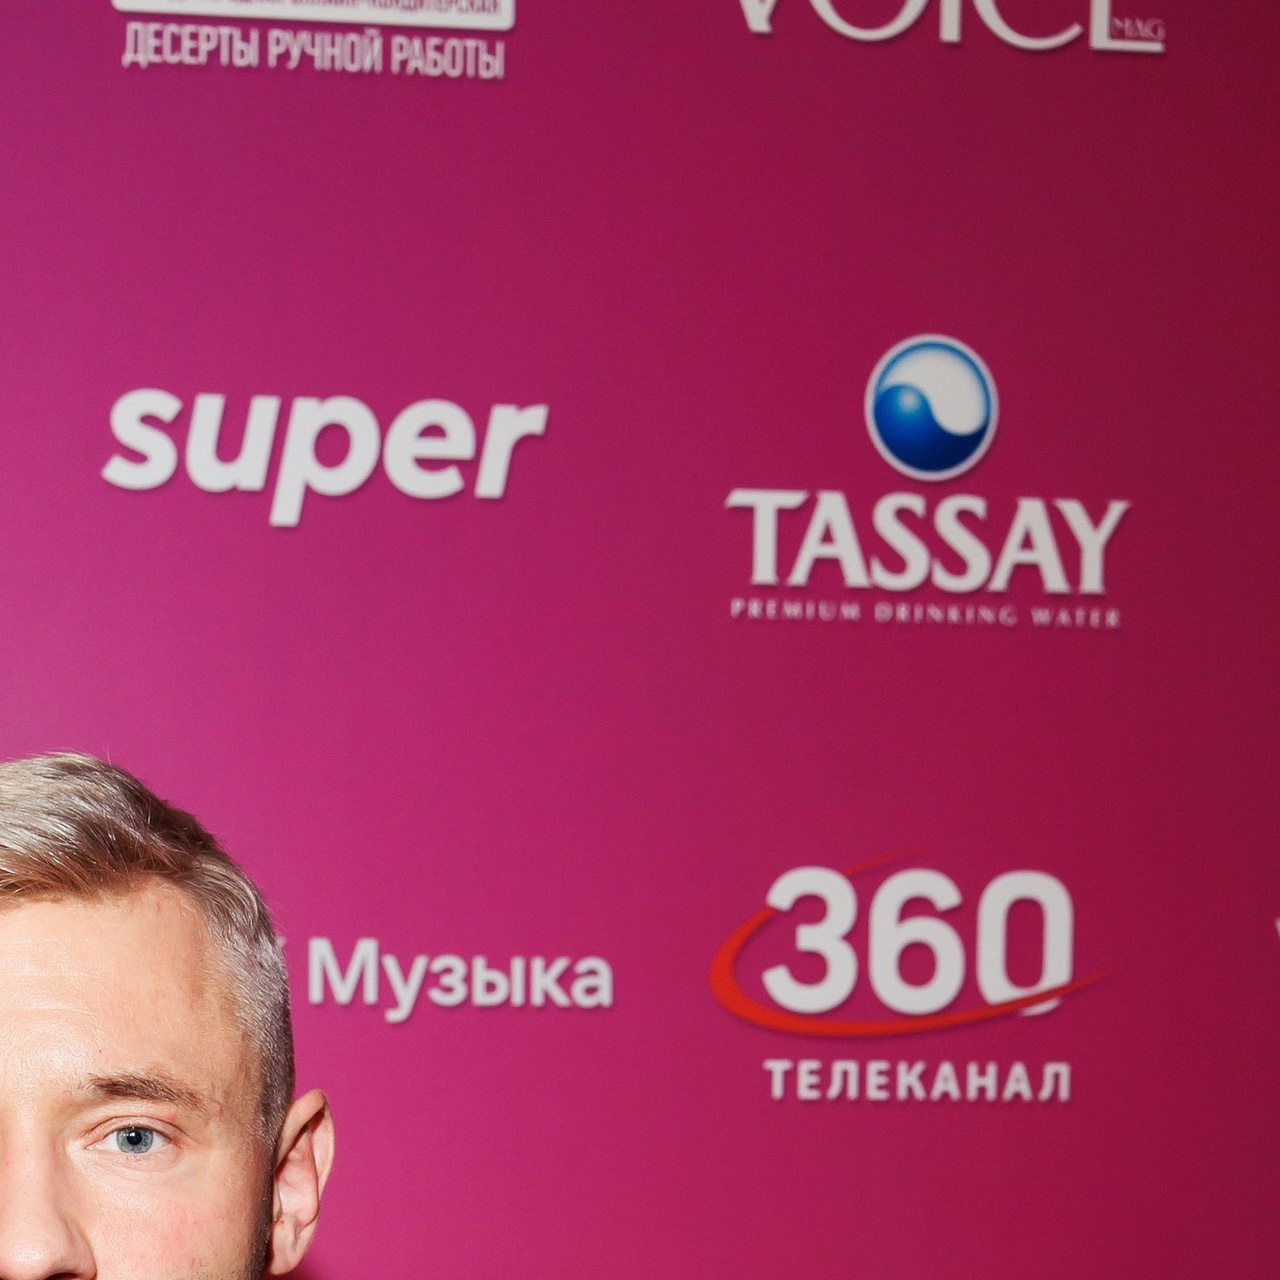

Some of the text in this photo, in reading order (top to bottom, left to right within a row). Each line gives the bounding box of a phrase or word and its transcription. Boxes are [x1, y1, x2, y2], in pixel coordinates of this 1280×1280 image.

[121, 21, 505, 80] ДЕСЕРТЫ РУЧНОЙ РАБОТЫ
[100, 387, 549, 527] super
[725, 488, 1129, 595] TASSAY
[729, 597, 1121, 629] PREMIUM DRINKING WATER
[307, 936, 613, 1023] Музыка
[761, 866, 1074, 1016] 360
[762, 1058, 1071, 1102] ТЕЛЕКАНАЛ
